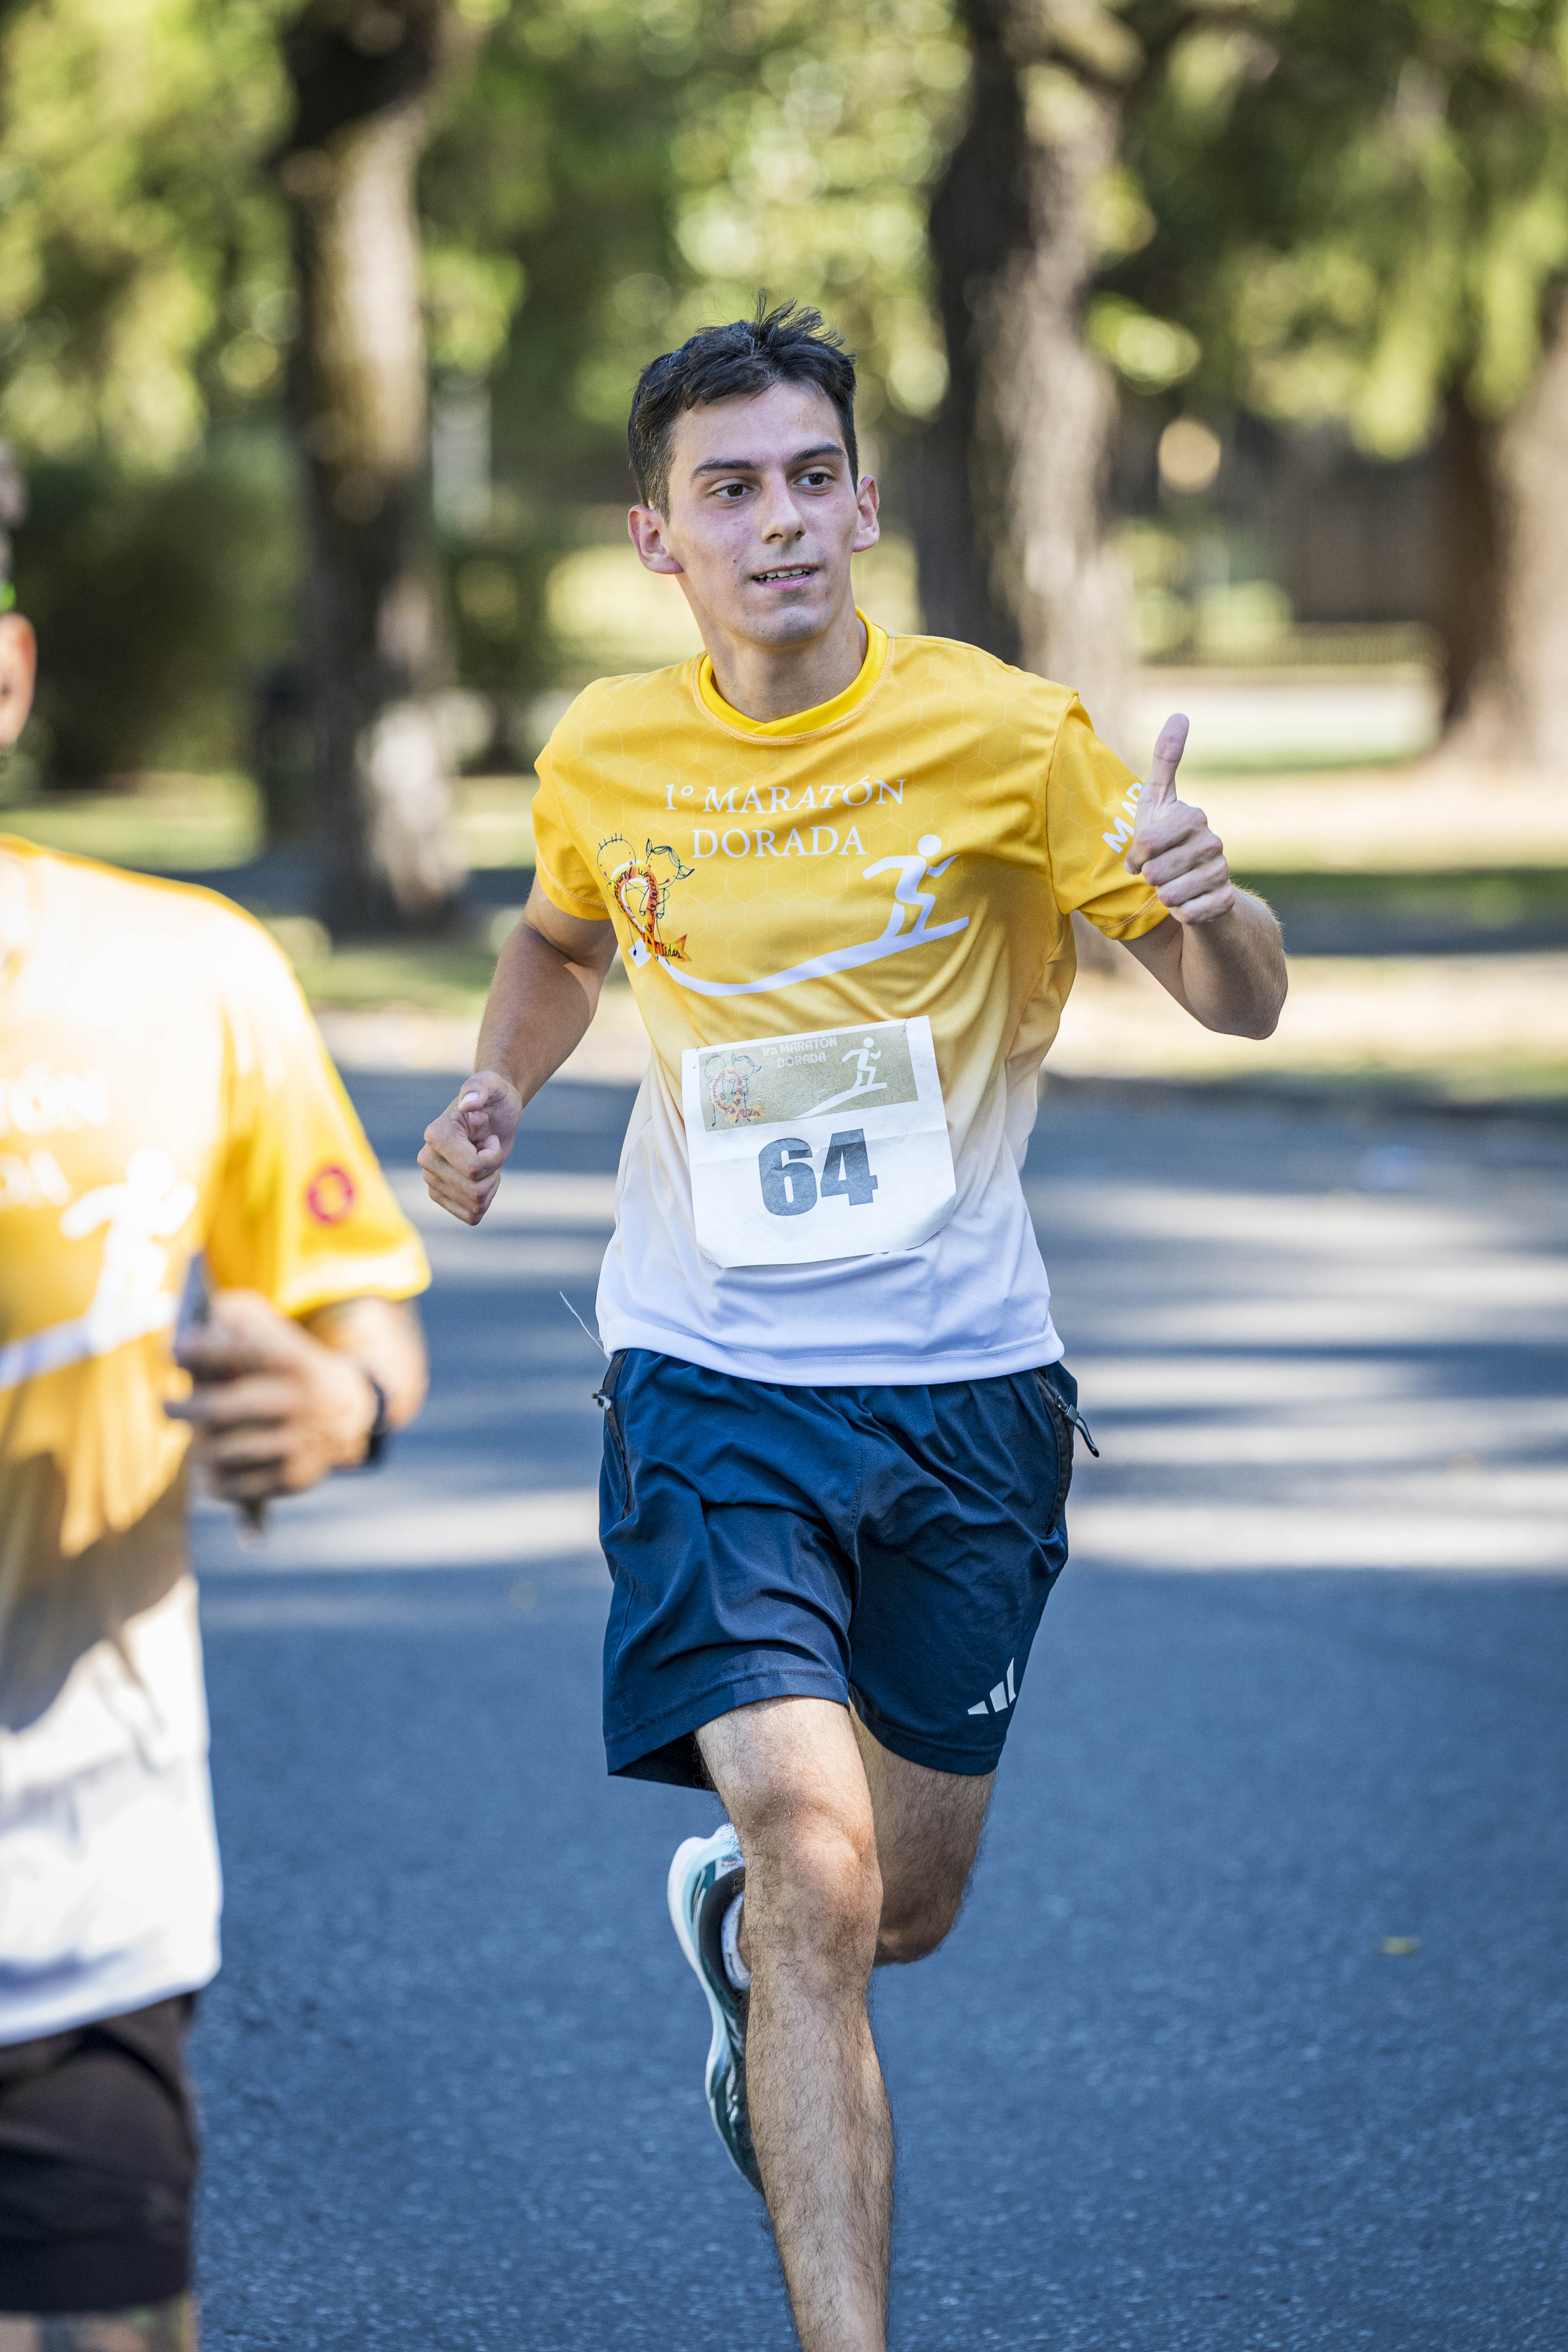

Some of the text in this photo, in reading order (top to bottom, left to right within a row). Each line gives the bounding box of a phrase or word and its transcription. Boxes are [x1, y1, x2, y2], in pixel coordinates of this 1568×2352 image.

[703, 775, 908, 814] MARATÓN
[691, 825, 867, 858] DORADA
[777, 1051, 827, 1068] DORADA
[758, 1128, 878, 1216] 64
